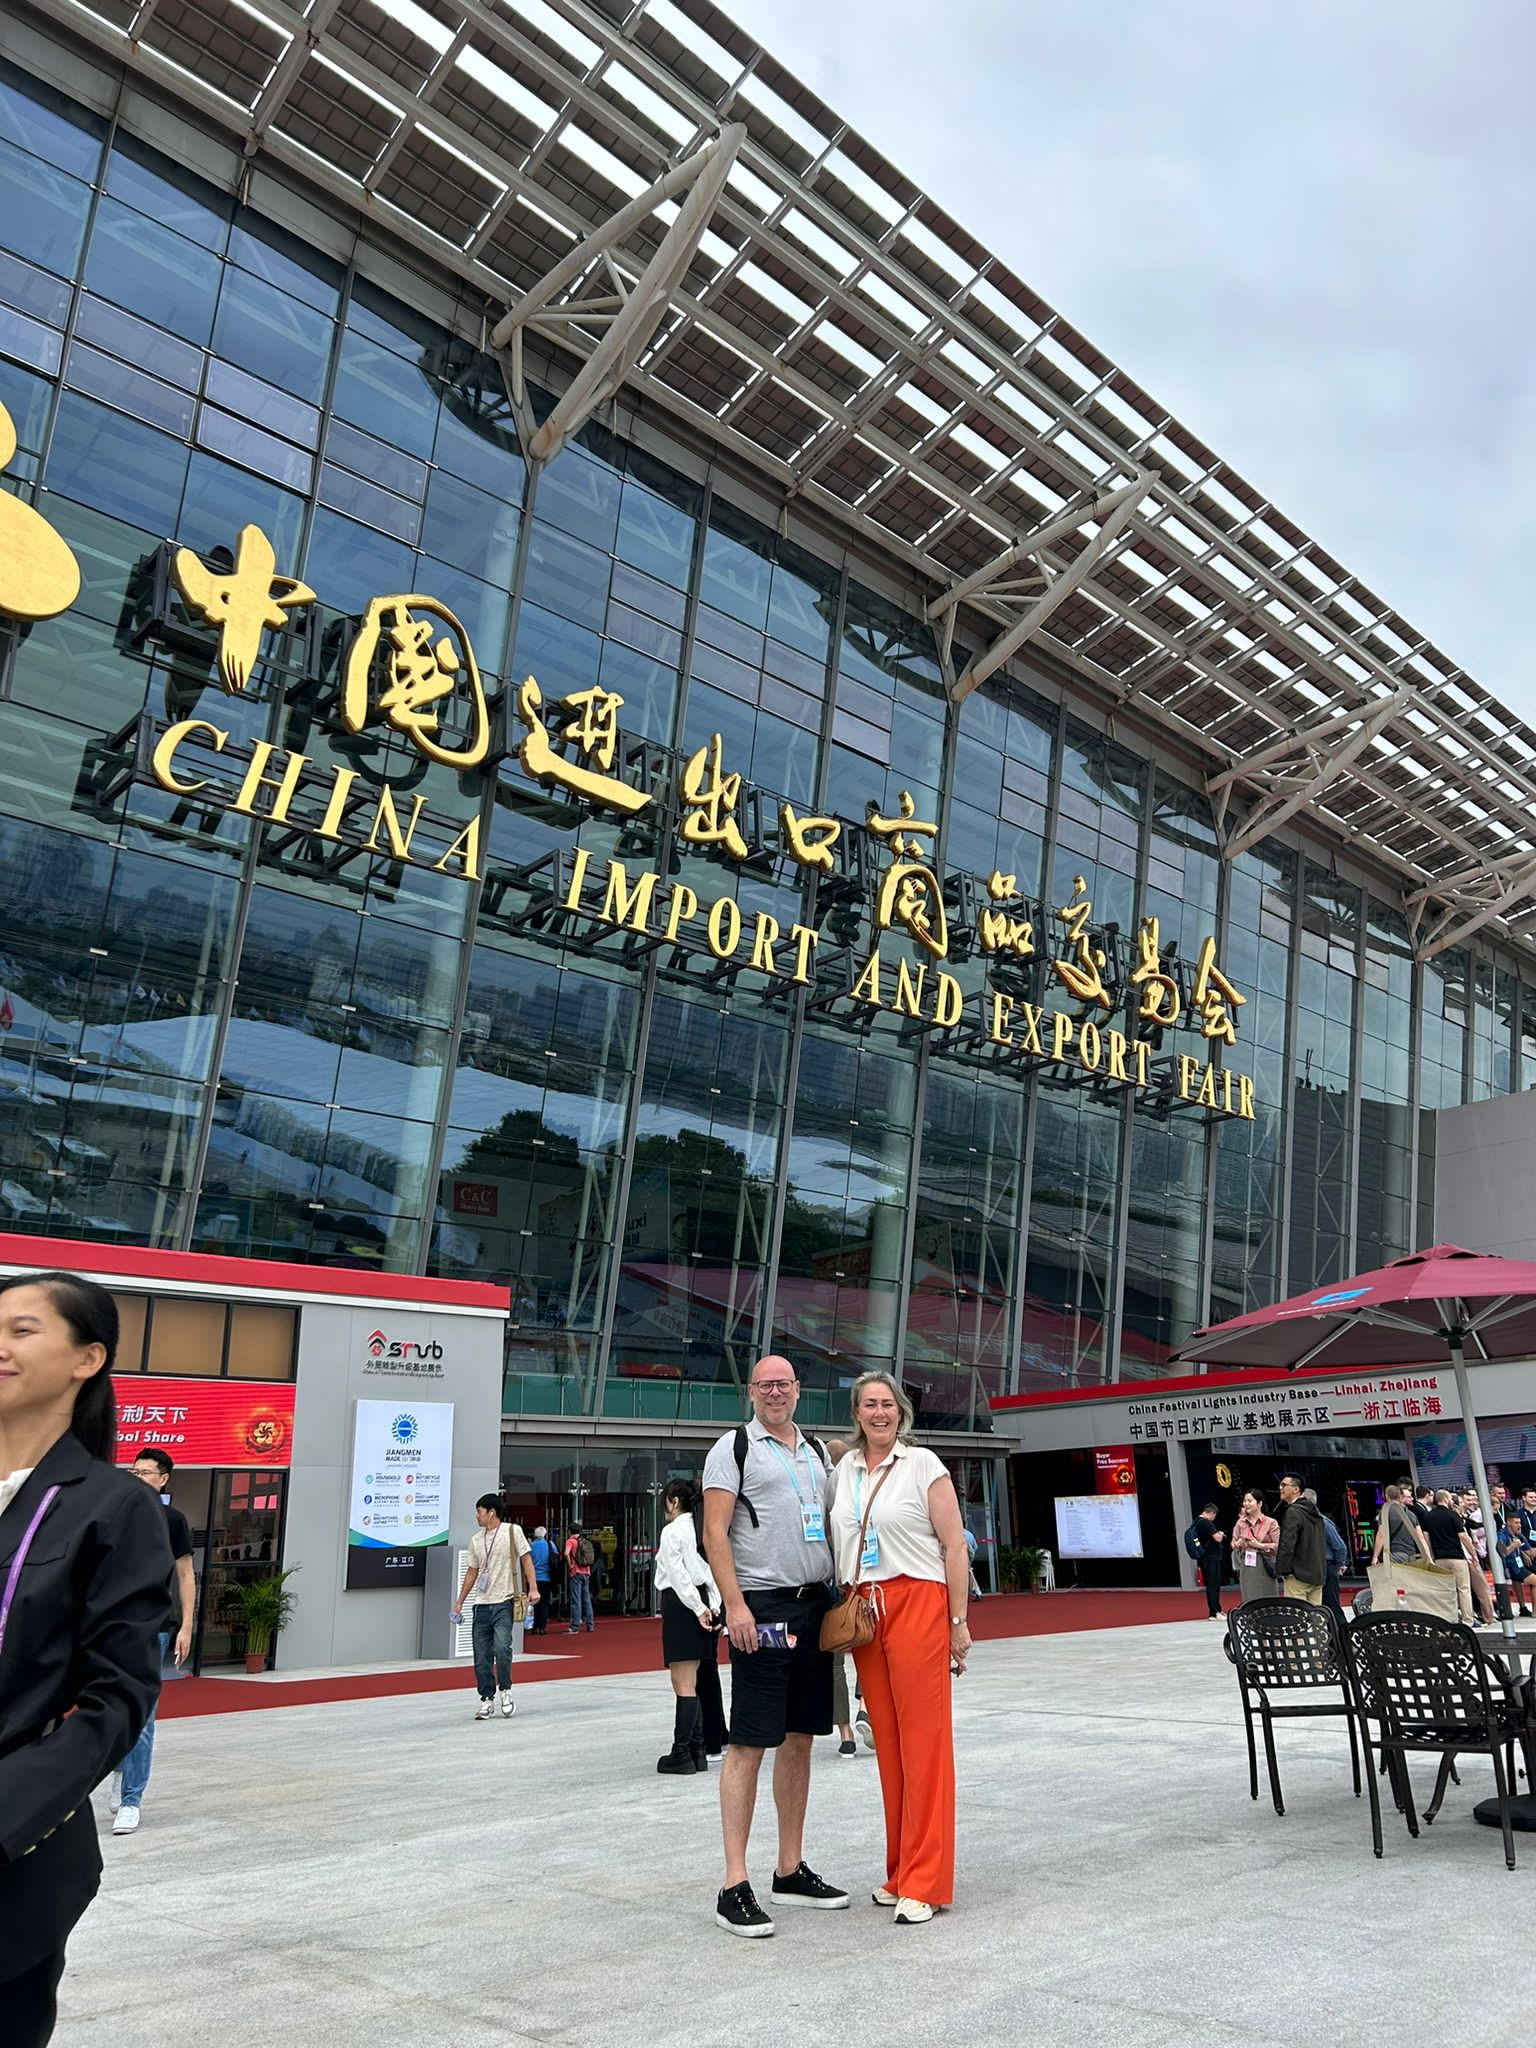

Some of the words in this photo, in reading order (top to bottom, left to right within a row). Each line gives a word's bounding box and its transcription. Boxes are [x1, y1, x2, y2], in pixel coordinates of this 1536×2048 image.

[153, 719, 481, 881] CHINA
[562, 847, 818, 984] IMPORT
[850, 949, 963, 1027] AND
[991, 991, 1151, 1088] EXPORT
[1178, 1054, 1256, 1120] FAIR
[628, 1212, 648, 1229] uxi
[1129, 1405, 1157, 1416] China
[1159, 1399, 1201, 1413] Festival
[1203, 1396, 1237, 1409] Lights
[1239, 1391, 1287, 1405] Industry
[1289, 1388, 1318, 1400] Base
[1379, 1376, 1438, 1391] Zhejiang
[114, 1430, 141, 1442] bal
[143, 1430, 185, 1443] Share
[385, 1448, 422, 1456] JIANGMEN
